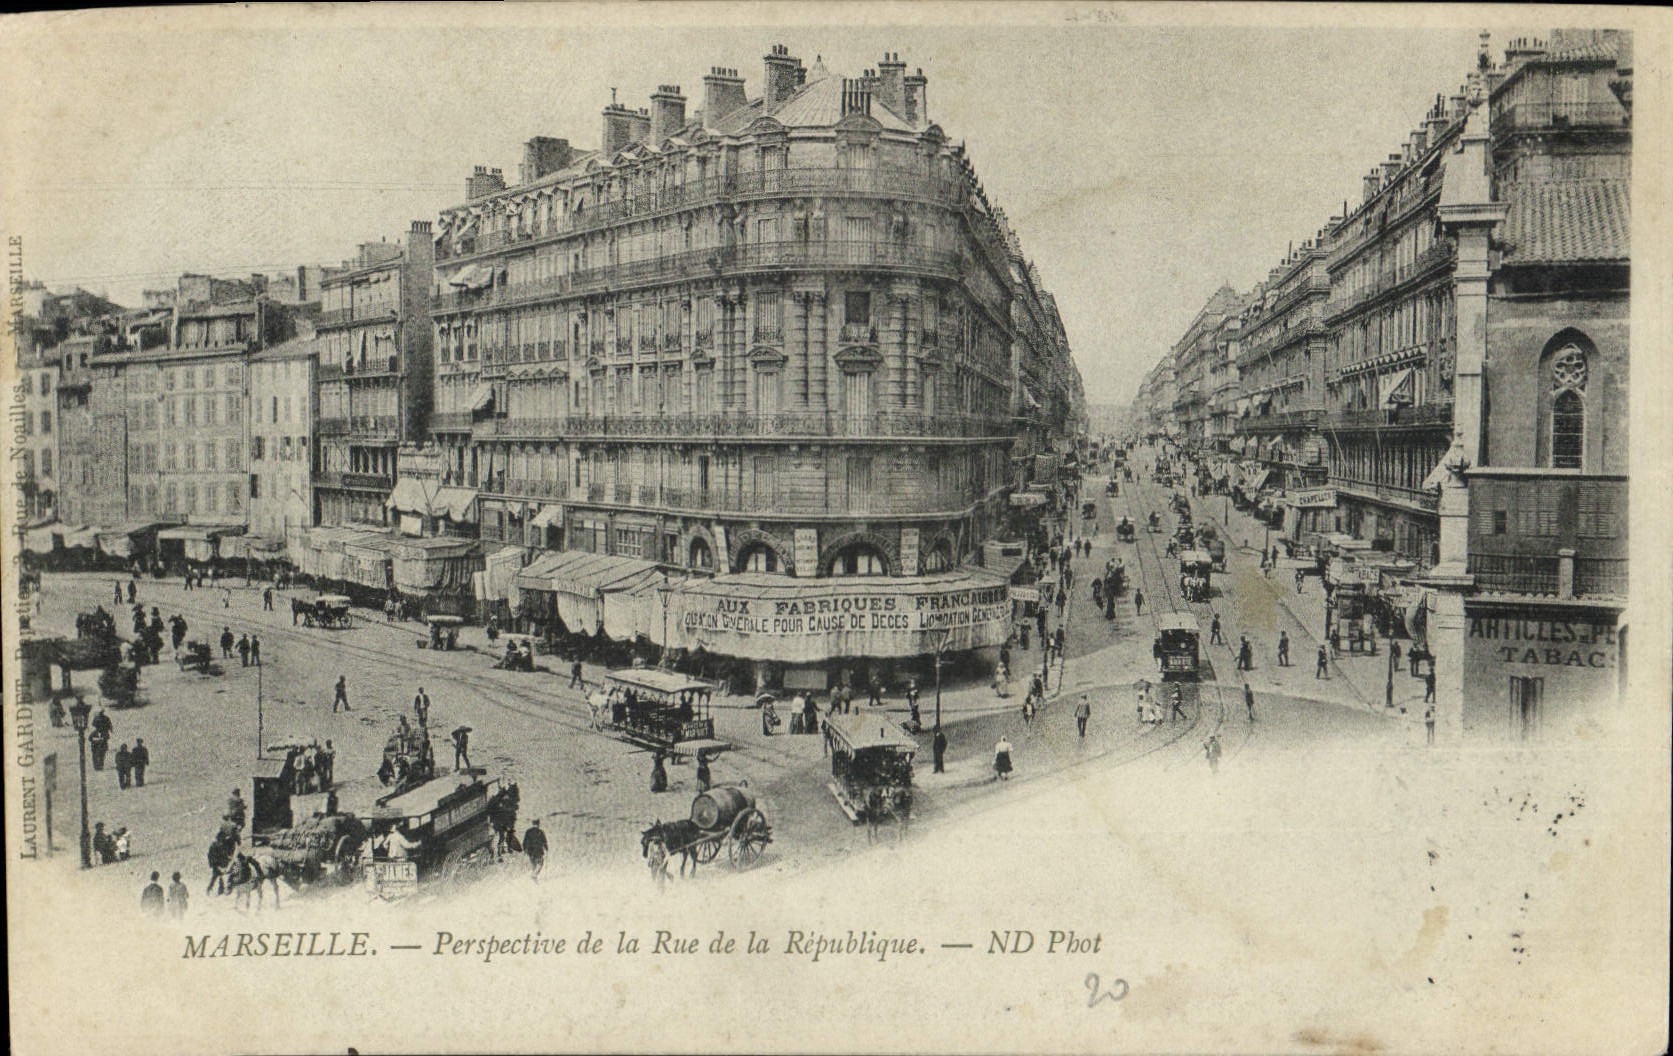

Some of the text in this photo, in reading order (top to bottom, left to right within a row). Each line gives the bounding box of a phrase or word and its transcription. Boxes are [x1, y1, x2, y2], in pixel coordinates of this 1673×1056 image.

[717, 599, 750, 615] AUX
[775, 597, 897, 616] FABRIQUES
[773, 618, 803, 633] POUR
[808, 615, 845, 631] CAUSE
[850, 614, 866, 630] DE
[871, 612, 909, 629] DECES
[1469, 618, 1577, 643] ARTICLES
